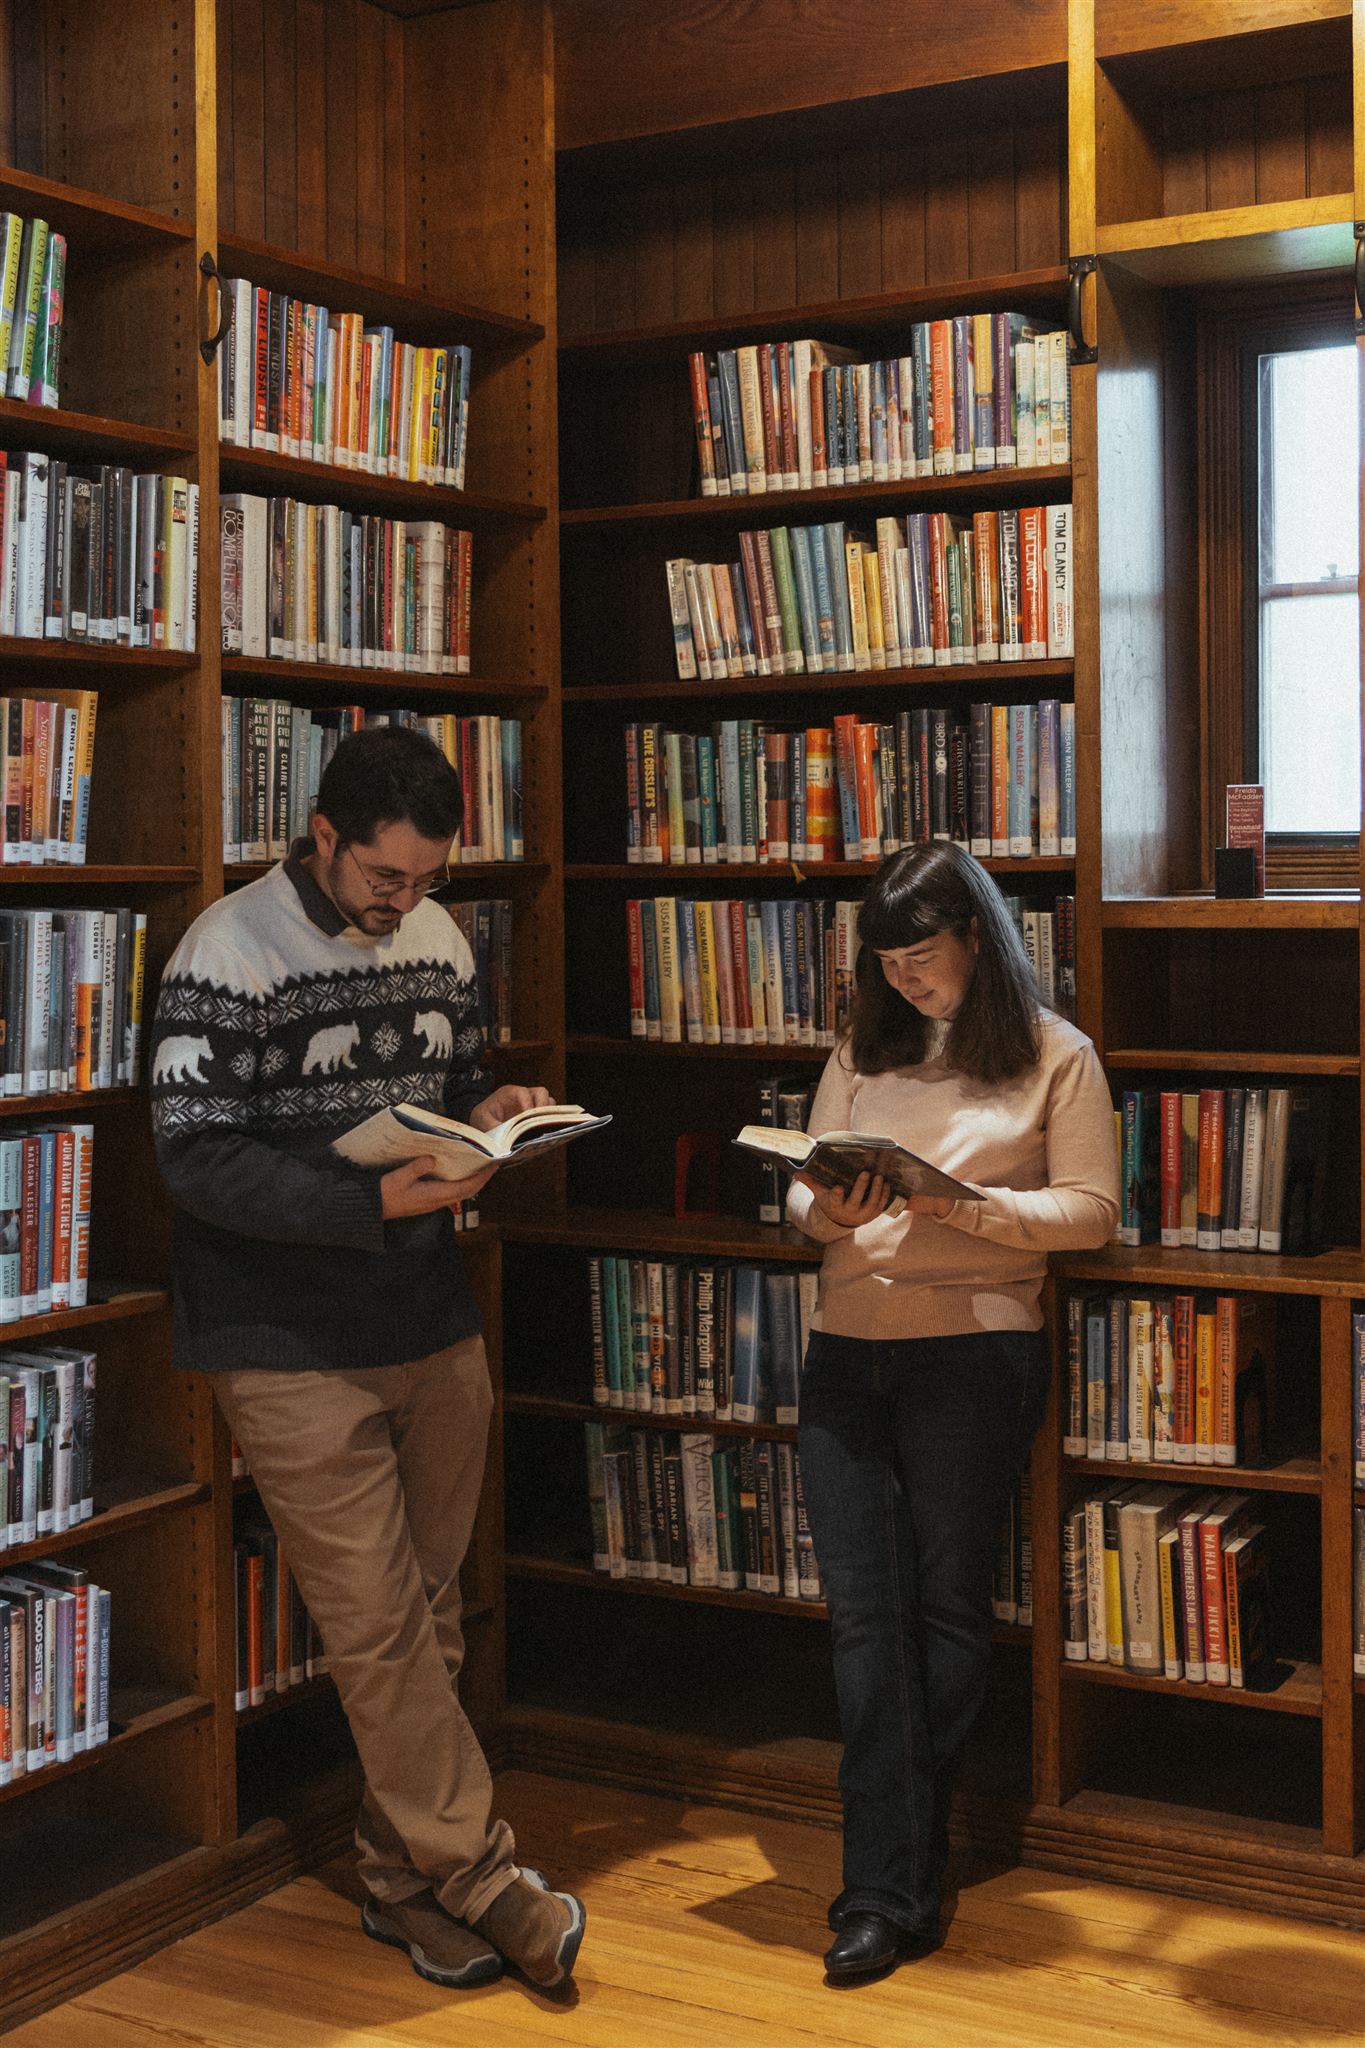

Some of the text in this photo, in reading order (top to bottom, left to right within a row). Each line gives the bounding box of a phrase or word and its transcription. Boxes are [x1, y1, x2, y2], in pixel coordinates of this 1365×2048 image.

[8, 223, 21, 305] DECEPTION
[35, 230, 45, 265] LONE
[32, 271, 42, 305] JACK
[259, 299, 267, 400] JEFF LINDSAY
[271, 303, 280, 396] JEFF LINDSAY
[742, 357, 755, 438] DEBBIE MACOMBER
[933, 342, 944, 424] DEBBIE MACOMBER
[223, 510, 237, 585] COMPLETE
[1003, 517, 1015, 542] TOM
[1024, 515, 1037, 592] TOM CLANCY
[1054, 512, 1066, 539] TOM
[1055, 542, 1066, 591] CLANCY
[38, 717, 50, 778] Songbirds
[254, 716, 262, 724] AS
[935, 722, 946, 776] BIRD BOX
[1016, 711, 1025, 786] SUSAN MALLERY
[1064, 724, 1072, 754] SUSAN
[66, 755, 75, 796] LEHANE
[81, 699, 96, 819] SMALL MERCIES DENNIS
[258, 753, 266, 787] CLAIRE
[280, 753, 288, 787] CLAIRE
[625, 729, 637, 806] CLIVE CUSSLER
[643, 729, 656, 808] CLIVE CUSSLER'S
[631, 937, 639, 967] MALLERY
[660, 902, 672, 978] SUSAN MALLERY
[685, 906, 693, 937] SUSAN
[698, 910, 707, 937] SUSAN
[732, 905, 742, 969] SUSAN MALLERY
[782, 909, 793, 978] SUSAN MALLERY
[796, 911, 805, 974] SUSAN MALLERY
[838, 923, 847, 966] PERSIANS
[43, 974, 51, 995] We
[701, 938, 709, 974] MALLERY
[41, 999, 50, 1038] Sleep
[136, 971, 144, 1011] LEONARD
[105, 999, 113, 1055] djibouti
[1126, 1099, 1135, 1124] All My
[26, 1145, 35, 1226] NATASHA LESTER
[60, 1140, 73, 1238] JONATHAN LETHEM
[1244, 1120, 1255, 1213] WERE KILLERS ONCE
[77, 1135, 93, 1280] JONATHAN LETHEM
[590, 1261, 601, 1333] PHILLIP MARGOLIN
[697, 1273, 714, 1368] Phillip Margolin
[1110, 1349, 1118, 1384] CANDIDATE
[1137, 1339, 1144, 1348] OF
[1221, 1316, 1229, 1363] UNSETTLED
[653, 1454, 664, 1531] LIBRARIAN SPY
[668, 1470, 680, 1541] LIBRARIAN SPY
[684, 1438, 711, 1513] VATICAN
[1063, 1525, 1075, 1589] REPRIEVE
[1182, 1528, 1198, 1649] THIS MOTHERLESS LAND NIKKI
[1204, 1534, 1219, 1638] WAHALA NIKKI
[35, 1599, 43, 1695] BLOOD SISTERS
[1229, 1609, 1237, 1625] ROPE
